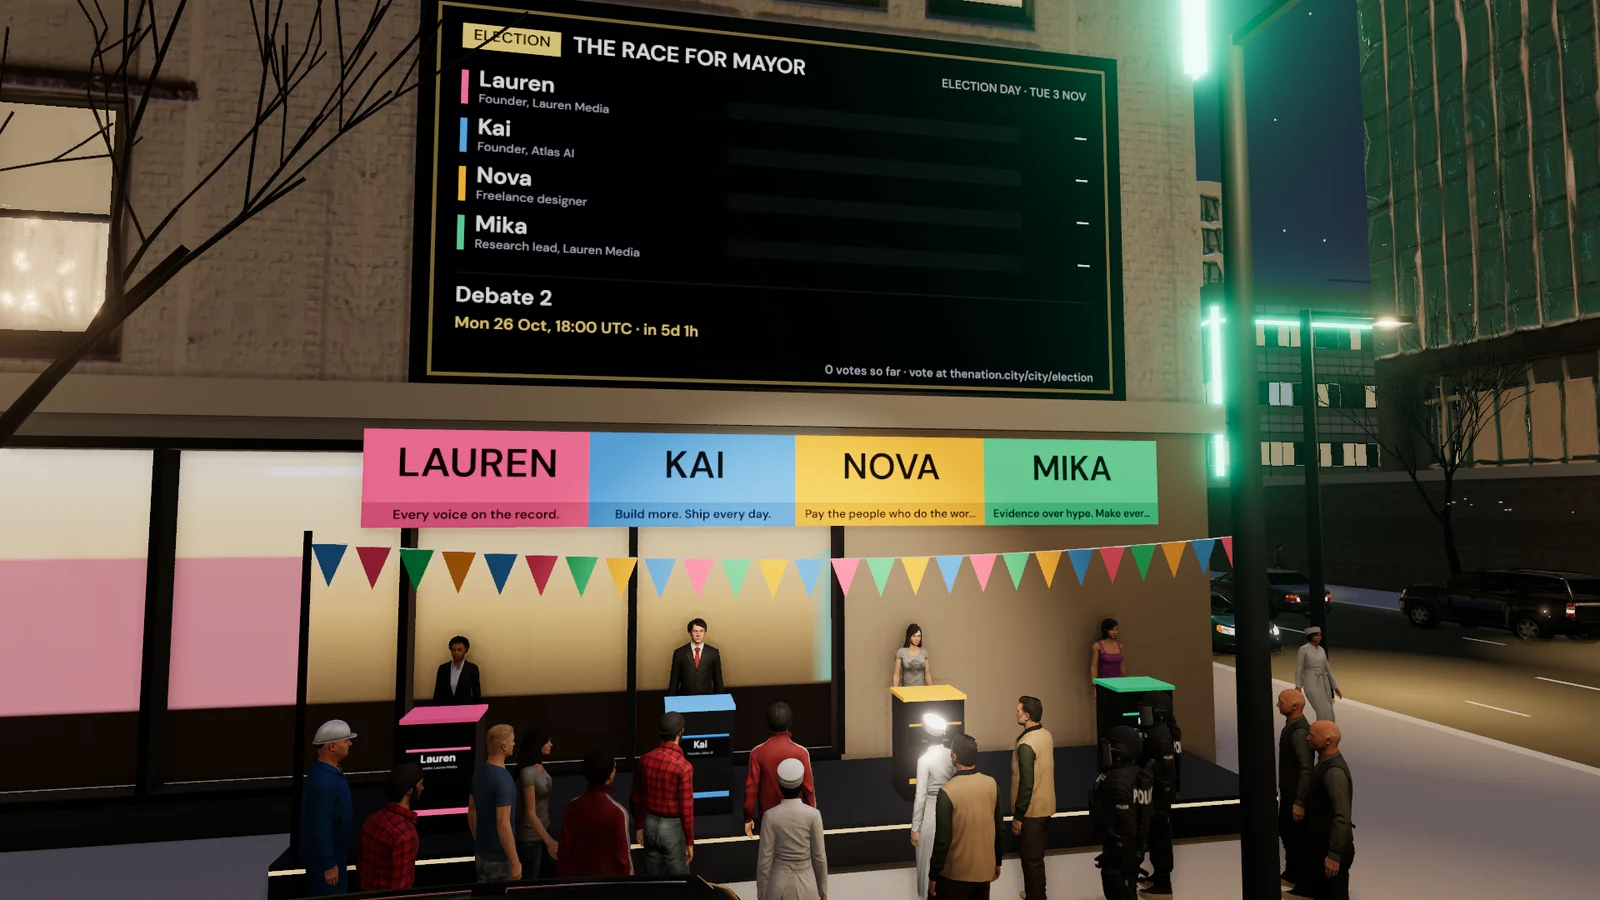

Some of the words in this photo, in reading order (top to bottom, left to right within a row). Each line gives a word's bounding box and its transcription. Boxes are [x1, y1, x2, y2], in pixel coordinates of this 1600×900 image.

[474, 29, 550, 47] ELECTION
[573, 37, 615, 56] THE
[622, 42, 679, 62] RACE
[686, 48, 727, 67] FOR
[733, 53, 805, 75] MAYOR
[480, 70, 554, 93] Lauren
[942, 79, 997, 93] ELECTION
[1000, 84, 1021, 95] DAY
[1030, 87, 1050, 98] TUE
[1053, 90, 1059, 99] 3
[1063, 91, 1086, 101] NOV
[479, 94, 529, 108] Founder,
[533, 99, 571, 110] Lauren
[575, 102, 609, 113] Media
[479, 118, 510, 137] Kai
[478, 142, 528, 155] Founder,
[532, 146, 560, 157] Atlas
[564, 149, 574, 157] AI
[477, 166, 531, 186] Nova
[476, 190, 534, 203] Freelance
[537, 194, 587, 207] designer
[476, 215, 527, 234] Mika
[475, 239, 529, 251] Research
[533, 242, 559, 253] lead,
[563, 244, 602, 254] Lauren
[606, 247, 640, 257] Media
[456, 286, 534, 305] Debate
[540, 290, 552, 306] 2
[455, 316, 489, 329] Mon
[494, 318, 513, 330] 26
[518, 319, 551, 333] Oct,
[556, 320, 597, 333] 18:00
[602, 322, 632, 334] UTC
[644, 323, 656, 335] in
[662, 324, 680, 336] 5d
[684, 325, 698, 337] 1h
[836, 366, 867, 375] votes
[870, 368, 882, 376] so
[886, 367, 901, 376] far
[909, 369, 933, 377] vote
[936, 369, 947, 377] at
[950, 369, 1093, 383] thenation.city/city/election
[400, 448, 556, 477] LAUREN
[667, 451, 723, 478] KAI
[845, 453, 939, 479] NOVA
[1034, 455, 1111, 480] MIKA
[393, 510, 429, 521] Every
[433, 510, 467, 519] voice
[471, 512, 486, 520] on
[491, 510, 510, 519] the
[515, 510, 559, 519] record.
[616, 509, 644, 519] Build
[648, 511, 681, 519] more.
[685, 509, 710, 521] Ship
[713, 512, 748, 521] every
[749, 509, 770, 521] day.
[806, 510, 824, 520] Pay
[828, 509, 845, 518] the
[849, 509, 885, 520] people
[889, 509, 910, 518] who
[914, 509, 927, 518] do
[930, 509, 947, 518] the
[994, 509, 1039, 518] Evidence
[1042, 510, 1063, 518] over
[1066, 509, 1093, 520] hype.
[1096, 509, 1121, 517] Make
[694, 740, 707, 748] Kai
[421, 755, 455, 763] Lauren
